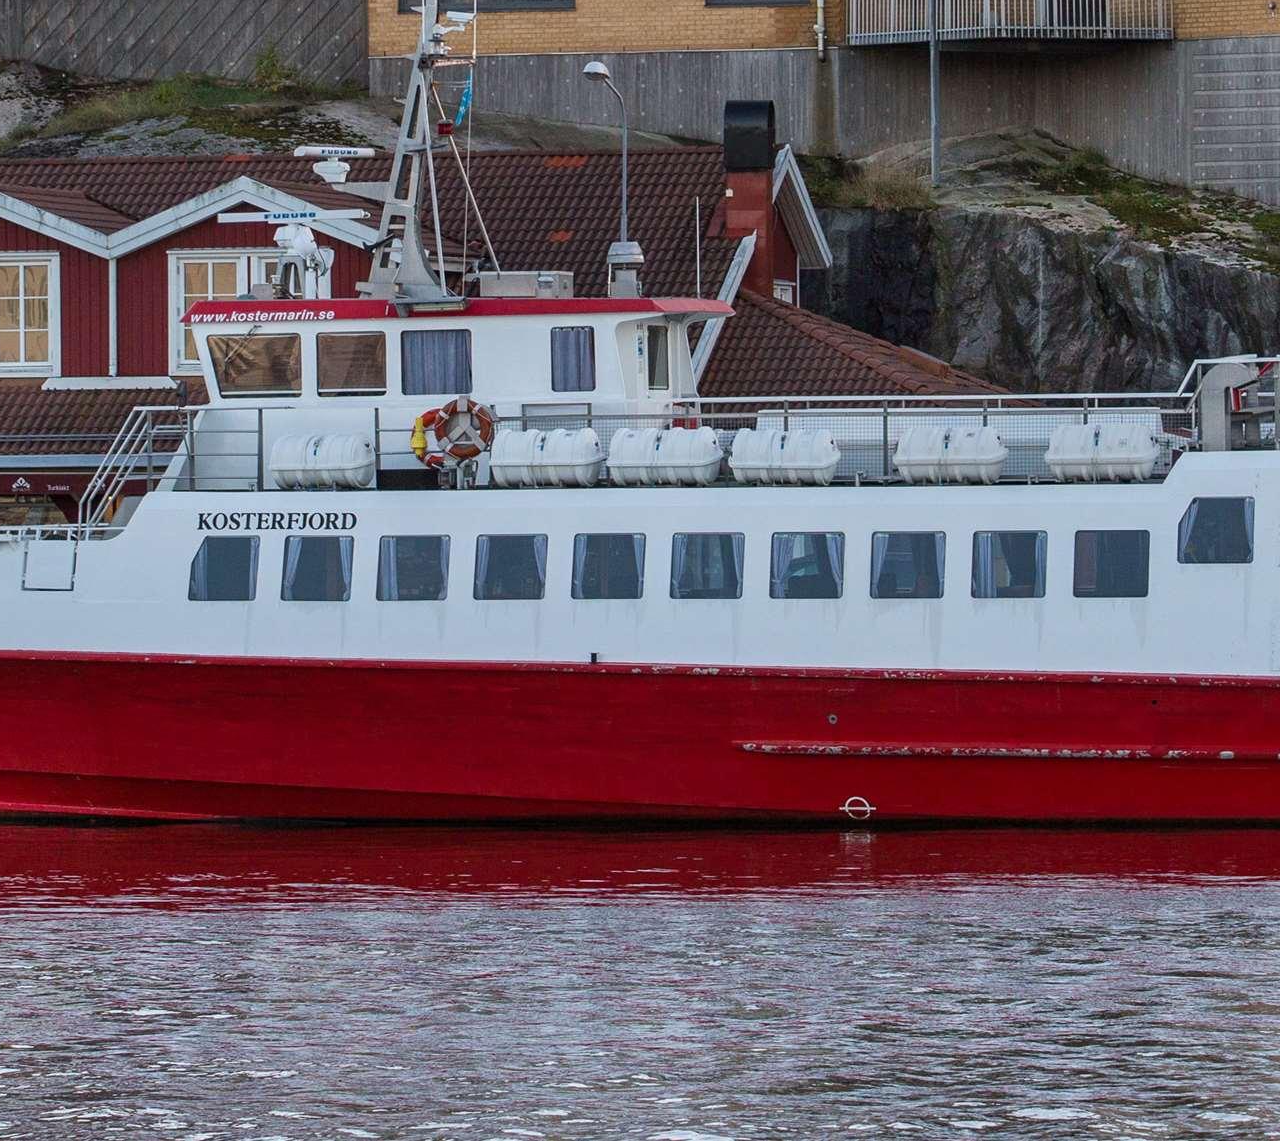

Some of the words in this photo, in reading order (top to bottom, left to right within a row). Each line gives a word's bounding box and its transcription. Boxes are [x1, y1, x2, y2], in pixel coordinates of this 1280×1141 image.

[264, 212, 316, 220] FURUNO
[190, 309, 336, 323] www.kostermarin.se
[197, 512, 357, 531] KOSTERFJORD
